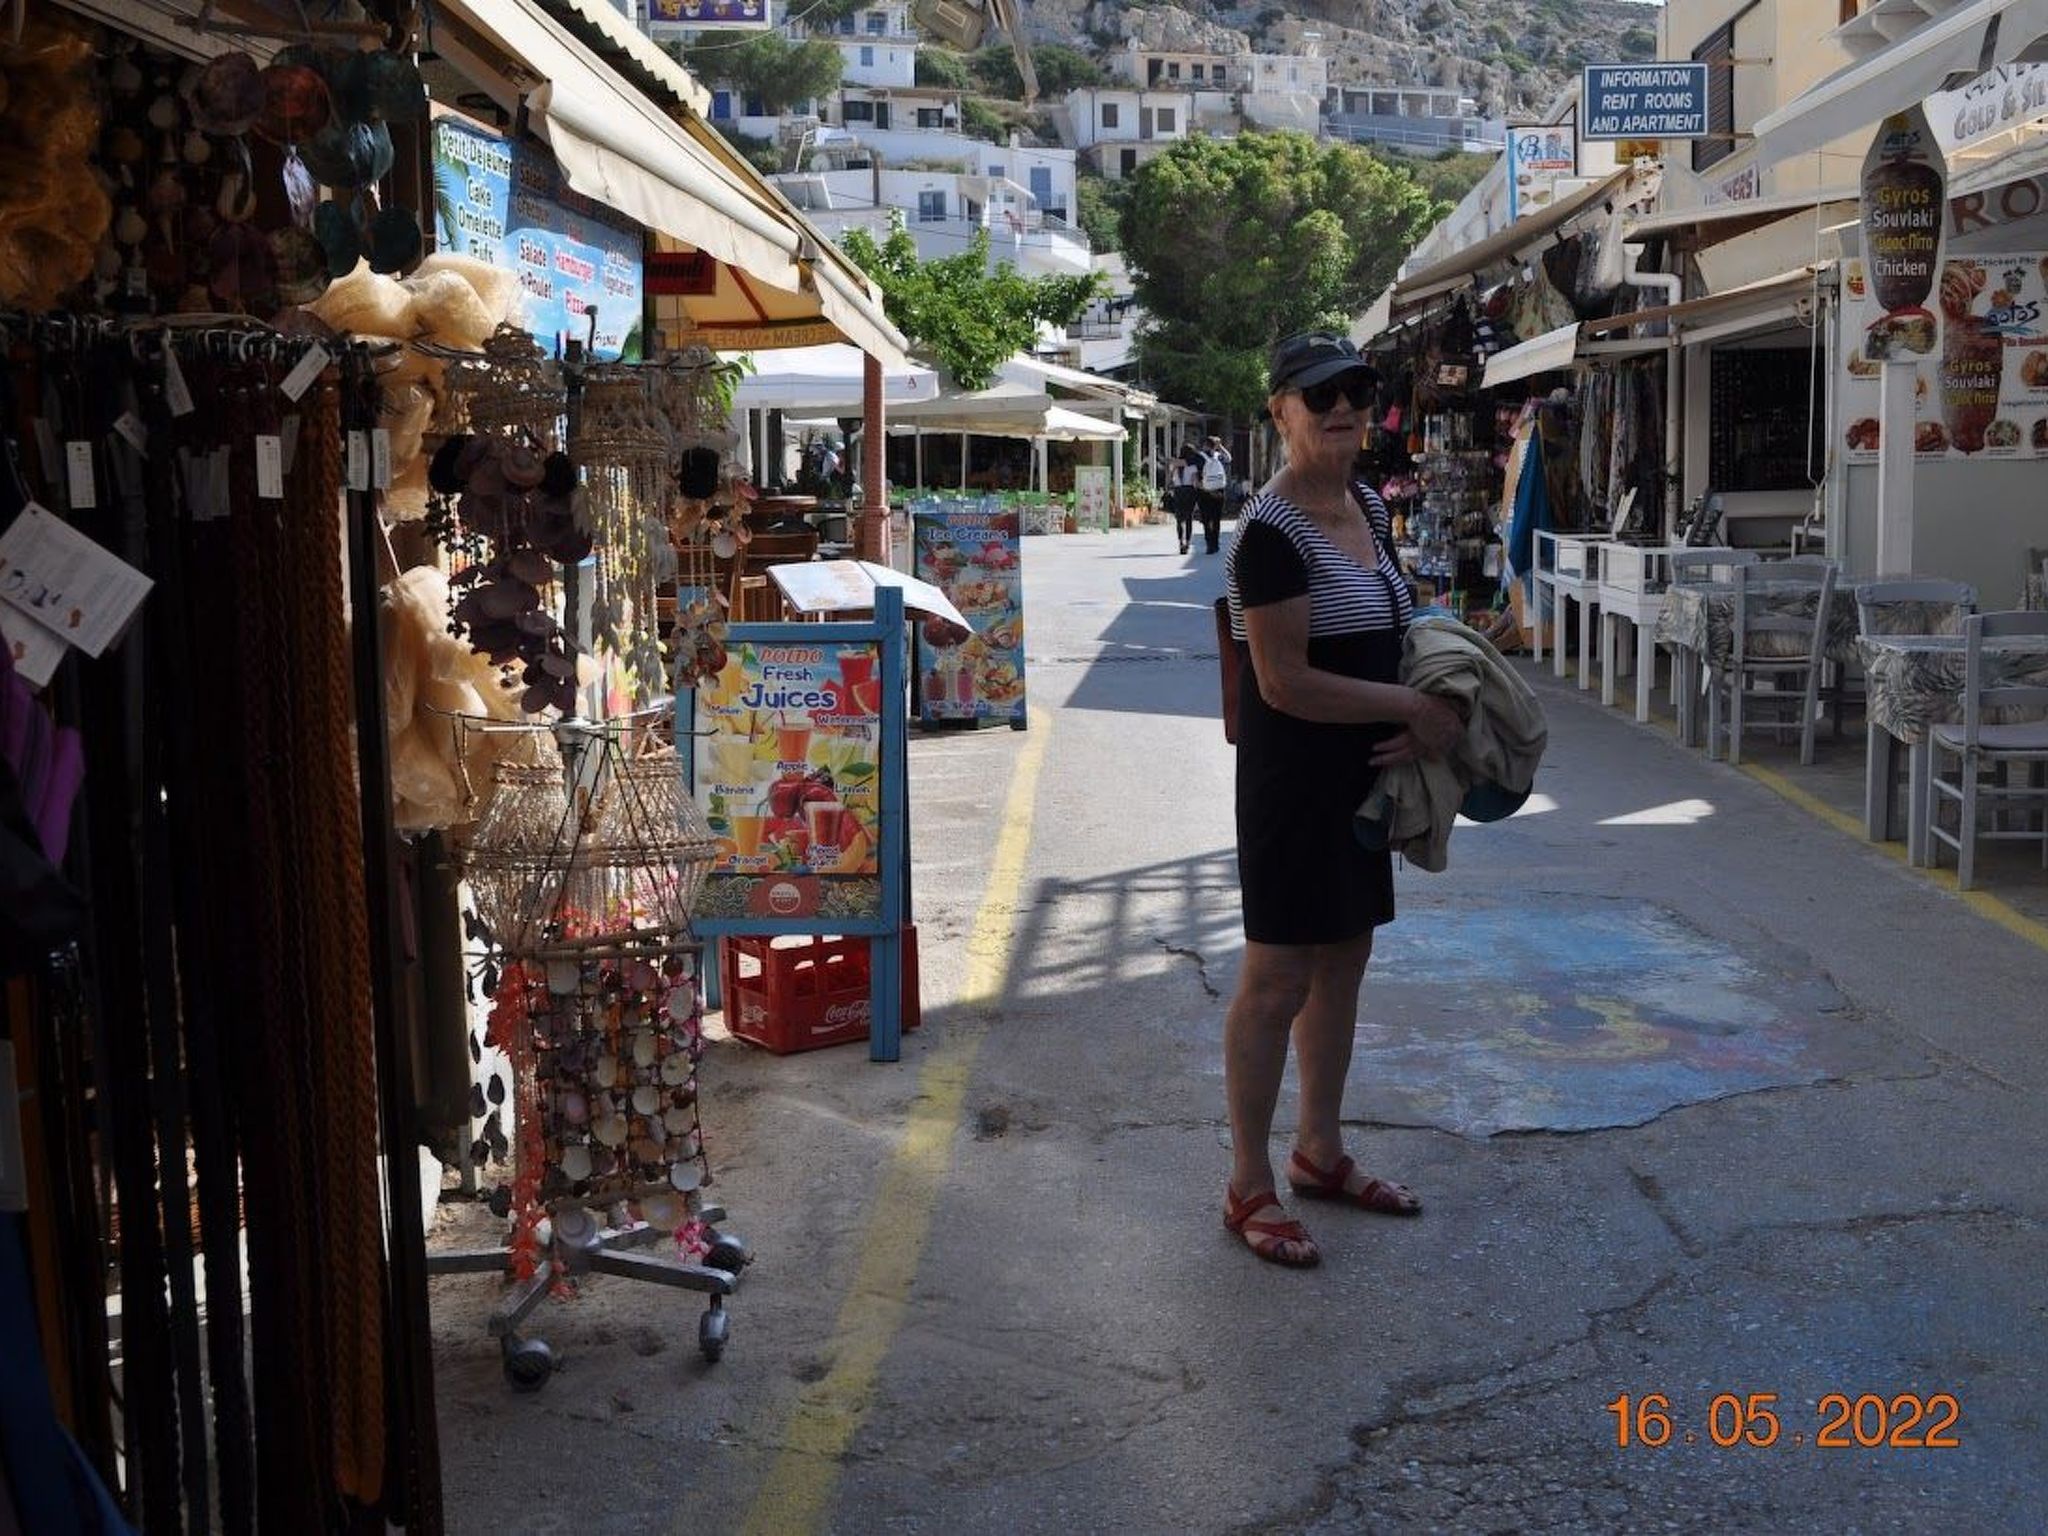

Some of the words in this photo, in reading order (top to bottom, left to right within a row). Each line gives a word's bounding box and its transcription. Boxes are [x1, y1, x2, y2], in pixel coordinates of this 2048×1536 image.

[1600, 70, 1690, 88] INFORMATION
[1601, 93, 1637, 110] RENT
[1644, 92, 1692, 109] ROOMS
[1591, 115, 1620, 132] AND
[1622, 113, 1702, 131] APARTMENT
[1954, 105, 1996, 140] GOLD
[467, 177, 492, 209] Cake
[1880, 186, 1930, 207] Gyros
[1872, 208, 1935, 228] Souvlaki
[1874, 258, 1928, 277] Chicken
[1950, 359, 1993, 374] Gyros
[1944, 374, 1997, 390] Souvlaki
[763, 665, 813, 681] Fresh
[741, 683, 836, 709] Juices
[776, 760, 809, 775] Apple
[714, 784, 755, 796] Banana
[728, 854, 769, 866] Orange
